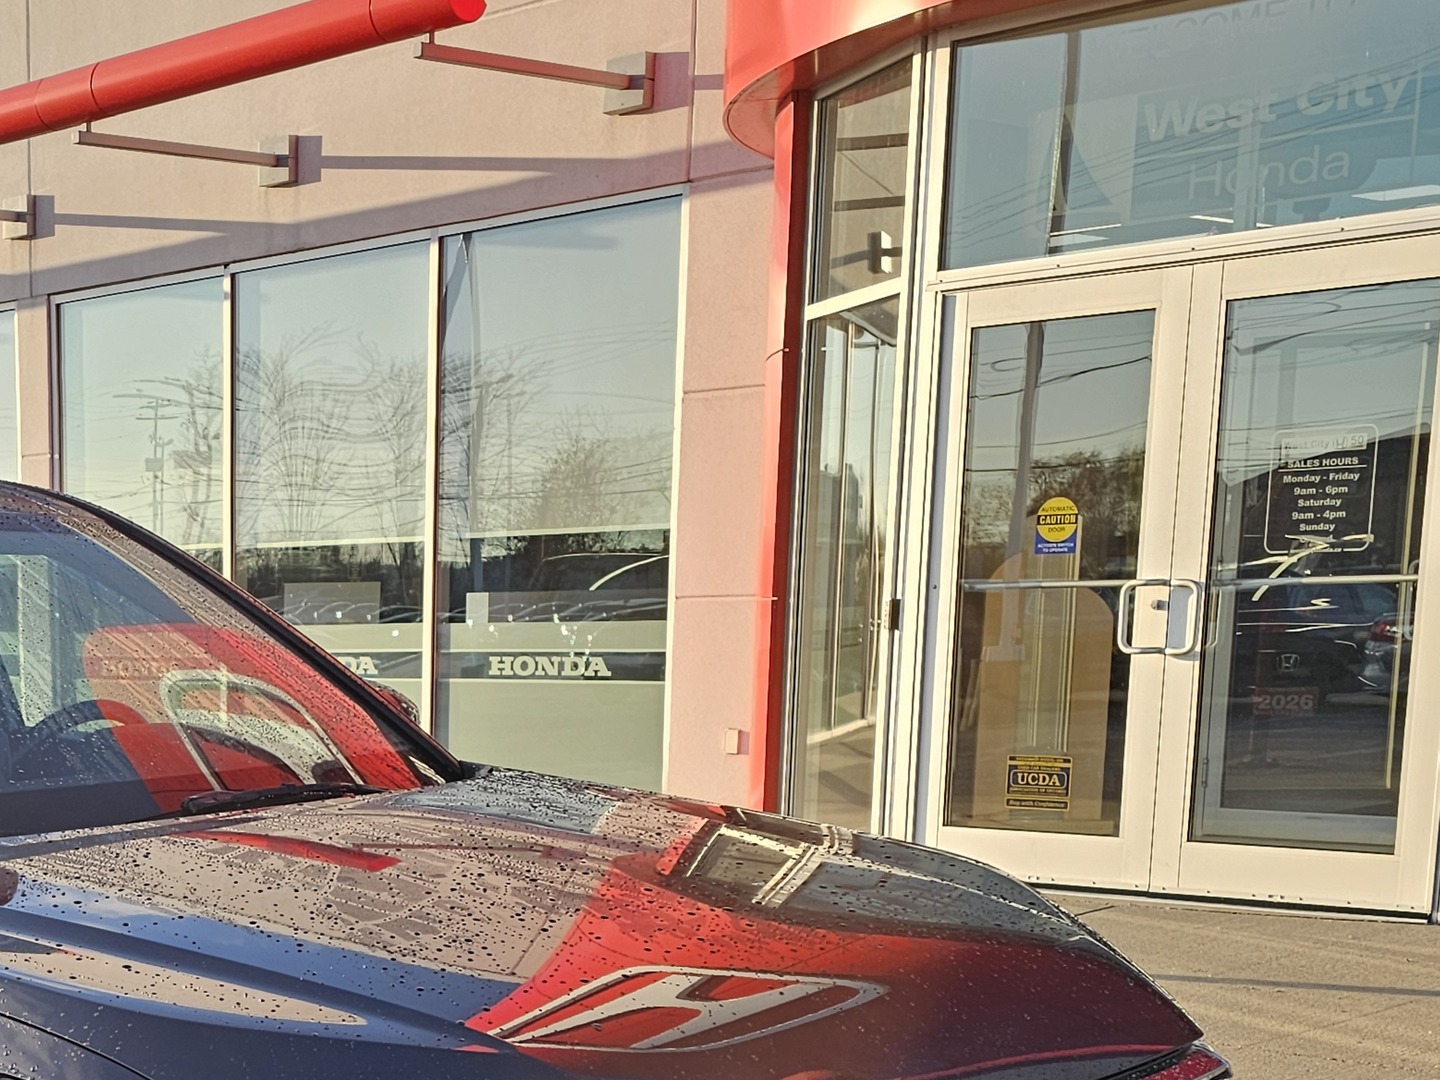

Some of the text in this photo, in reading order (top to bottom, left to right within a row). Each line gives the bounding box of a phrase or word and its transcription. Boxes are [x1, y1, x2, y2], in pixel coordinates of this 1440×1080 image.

[1144, 70, 1413, 142] West City
[1188, 145, 1350, 200] Honda
[1287, 457, 1359, 468] SALES HOURS
[1283, 475, 1321, 483] Monday
[1329, 472, 1360, 481] Friday
[1294, 487, 1316, 495] 9am
[1325, 485, 1348, 495] 6pm
[1297, 498, 1342, 507] Saturday
[1040, 514, 1076, 524] CAUTION
[1292, 512, 1314, 520] 9am
[1323, 510, 1346, 520] 4pm
[1299, 523, 1336, 532] Sunday
[489, 656, 612, 676] HONDA
[1258, 694, 1314, 710] 2026
[1017, 773, 1060, 786] UCDA
